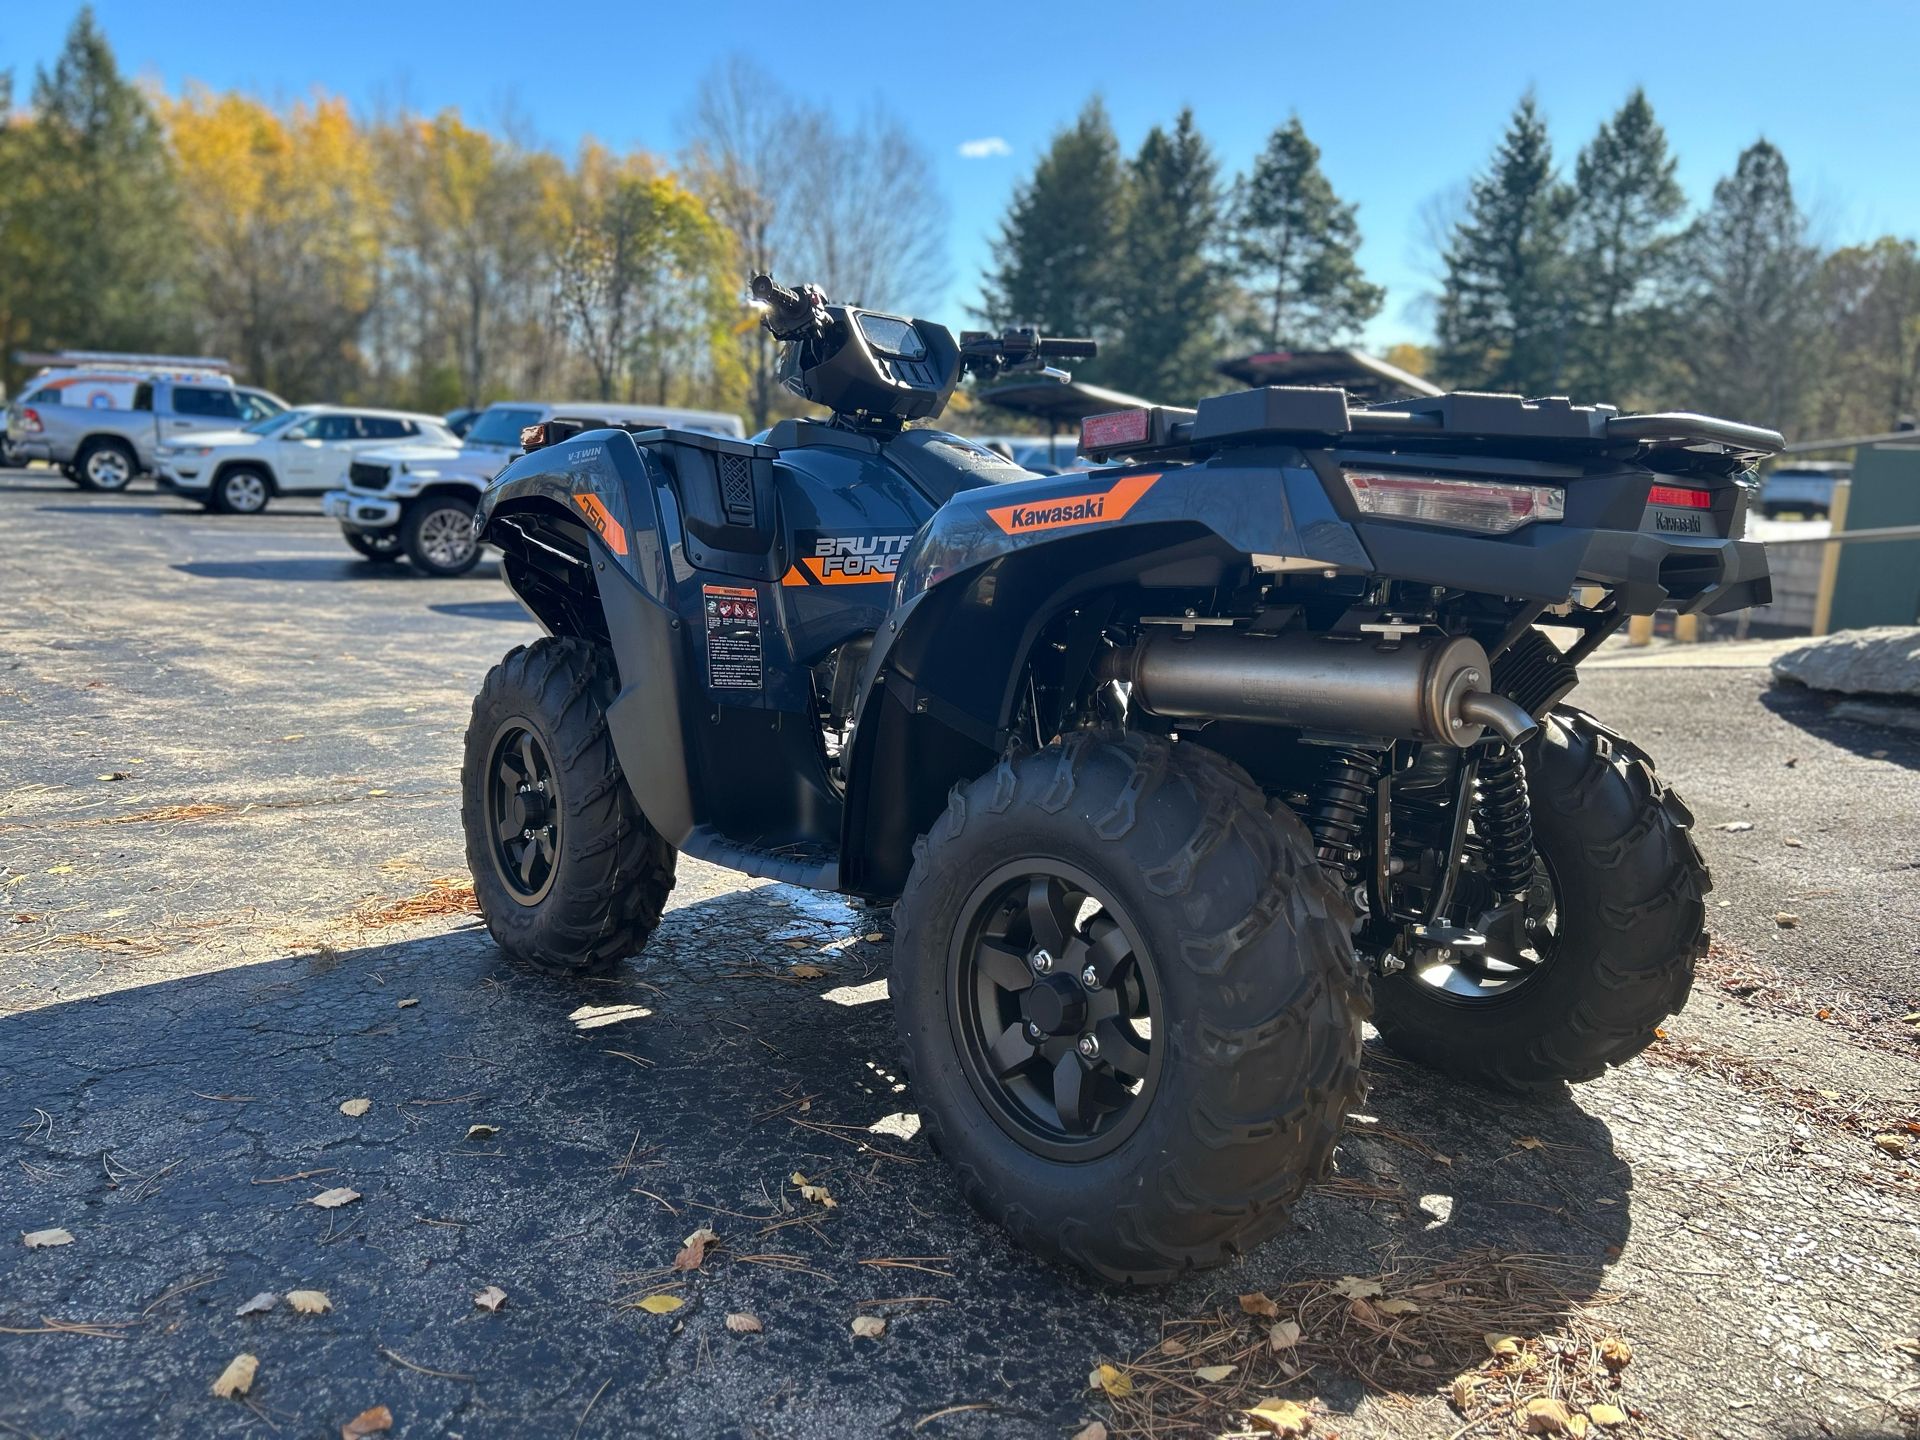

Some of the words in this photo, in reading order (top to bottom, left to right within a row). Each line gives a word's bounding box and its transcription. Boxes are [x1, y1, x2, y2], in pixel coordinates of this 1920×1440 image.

[568, 446, 602, 461] V-TWIN
[582, 496, 606, 531] 750
[1011, 497, 1104, 528] Kawasaki
[1655, 511, 1701, 533] Kawasaki
[823, 553, 902, 576] FORC
